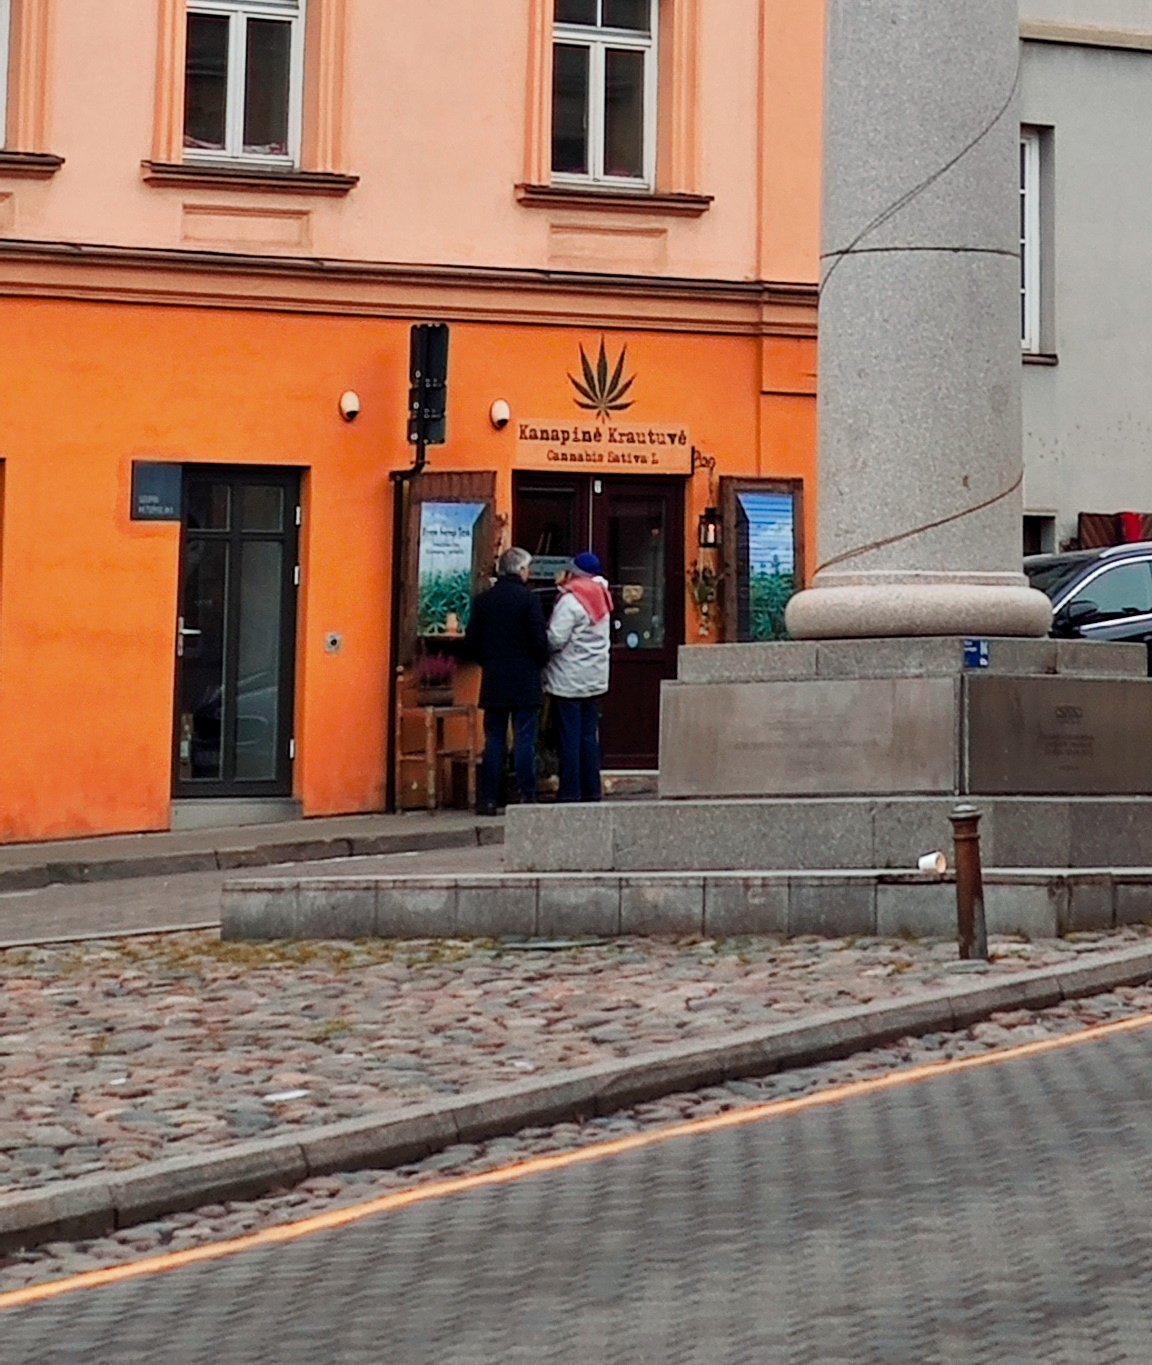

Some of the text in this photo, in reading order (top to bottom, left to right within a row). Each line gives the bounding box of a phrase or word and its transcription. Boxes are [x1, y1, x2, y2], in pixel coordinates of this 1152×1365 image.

[519, 424, 687, 446] Kanapinė Krautuvė
[547, 449, 604, 463] Cannabis
[607, 451, 648, 465] Sativa
